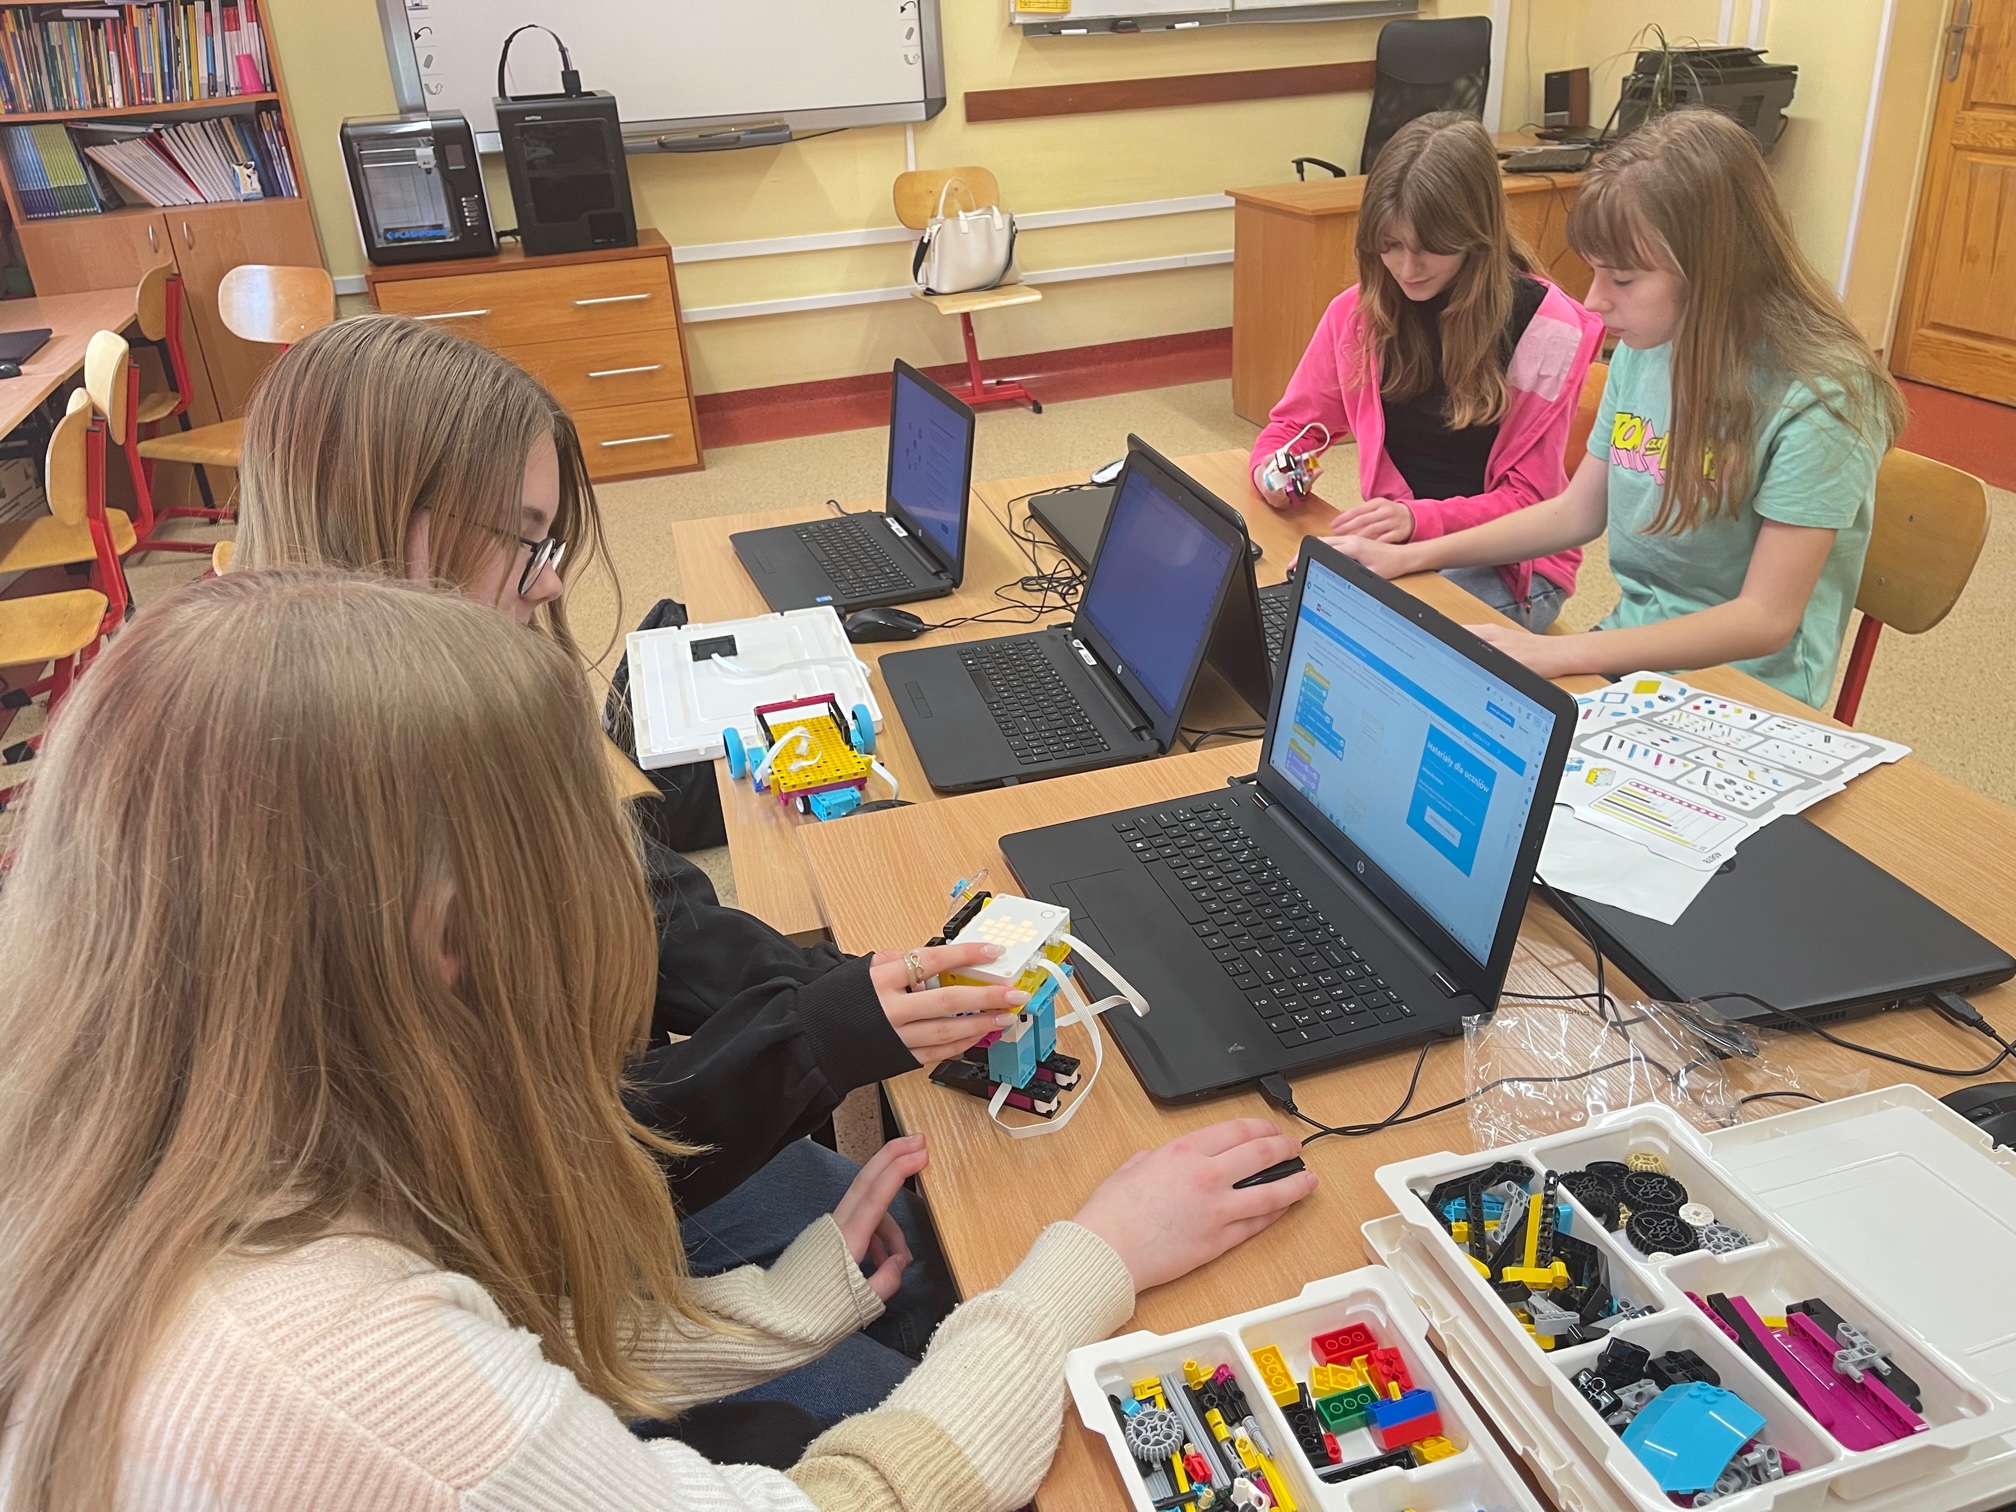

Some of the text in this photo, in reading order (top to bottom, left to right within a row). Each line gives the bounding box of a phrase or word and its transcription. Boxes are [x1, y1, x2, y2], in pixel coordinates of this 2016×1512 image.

[1427, 740, 1454, 768] Materiały
[1454, 761, 1464, 775] dla
[1464, 770, 1491, 794] uczniów
